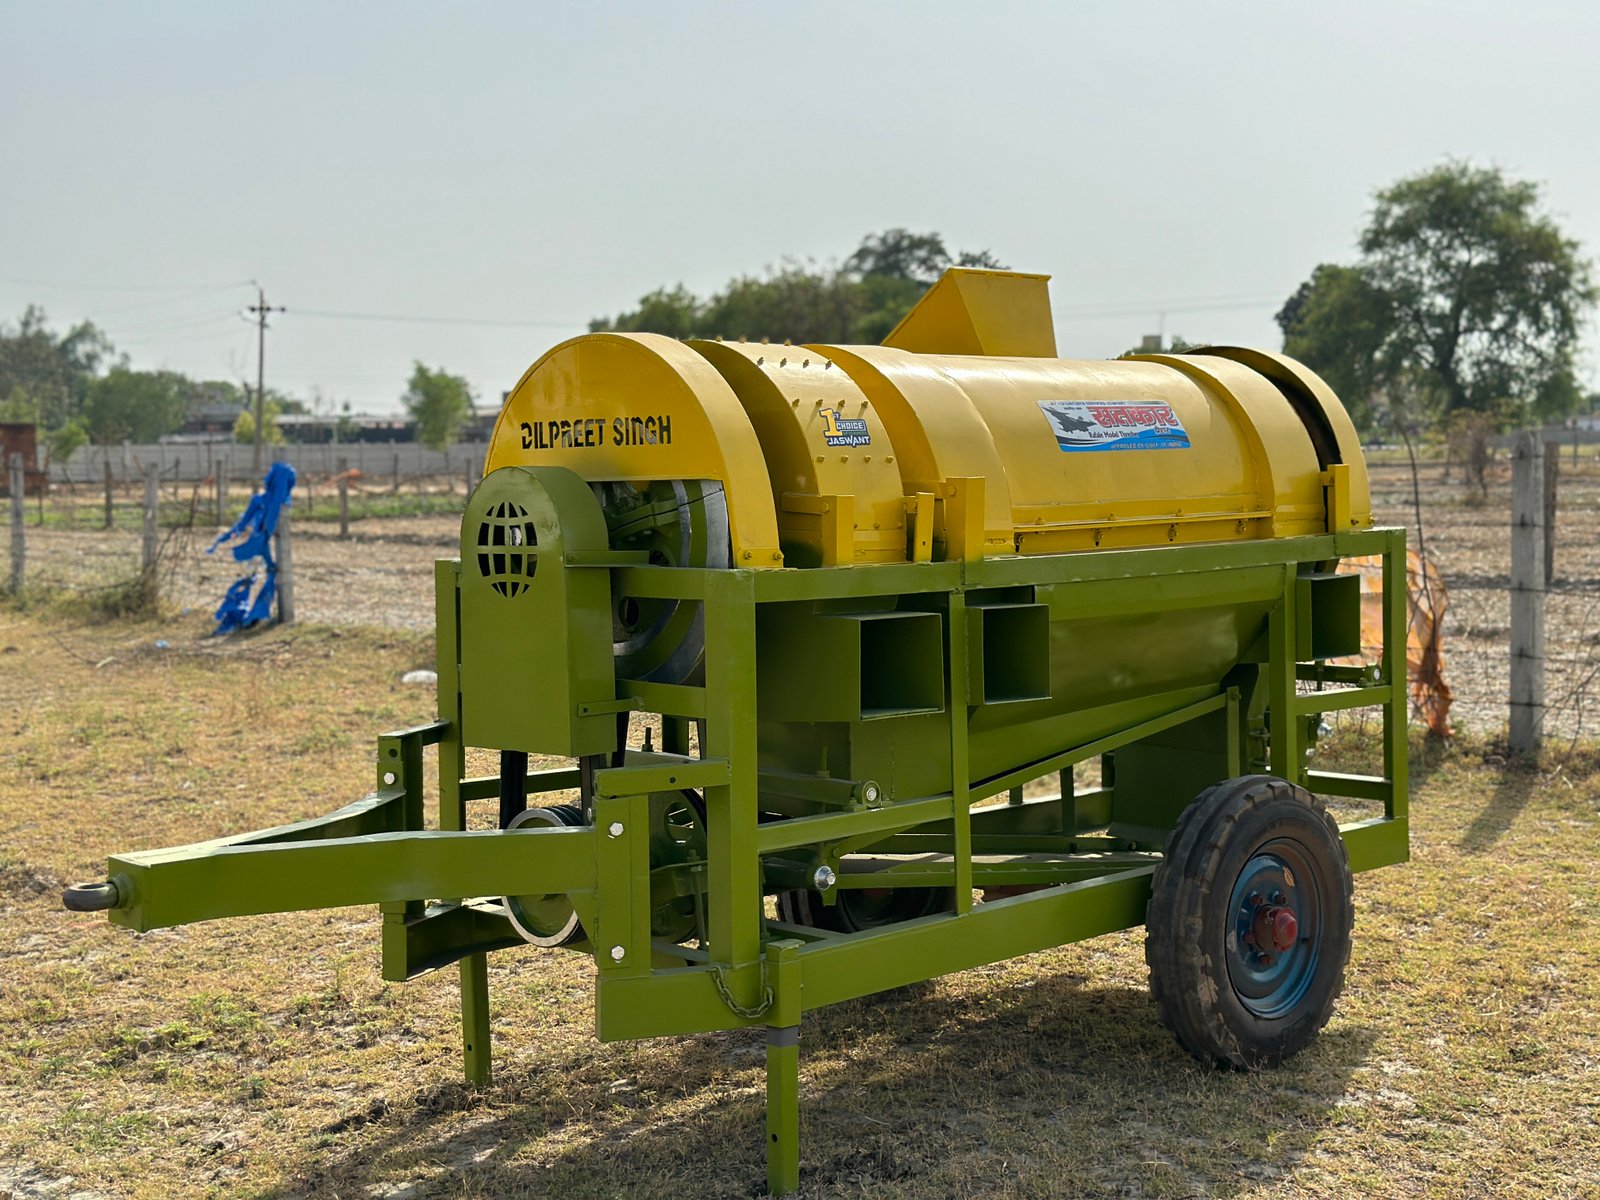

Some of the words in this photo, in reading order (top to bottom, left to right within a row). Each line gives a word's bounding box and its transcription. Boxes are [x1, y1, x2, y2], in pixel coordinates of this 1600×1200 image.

[836, 422, 863, 430] CHOICE
[521, 419, 606, 449] DILPREET
[828, 435, 870, 446] JASWANT
